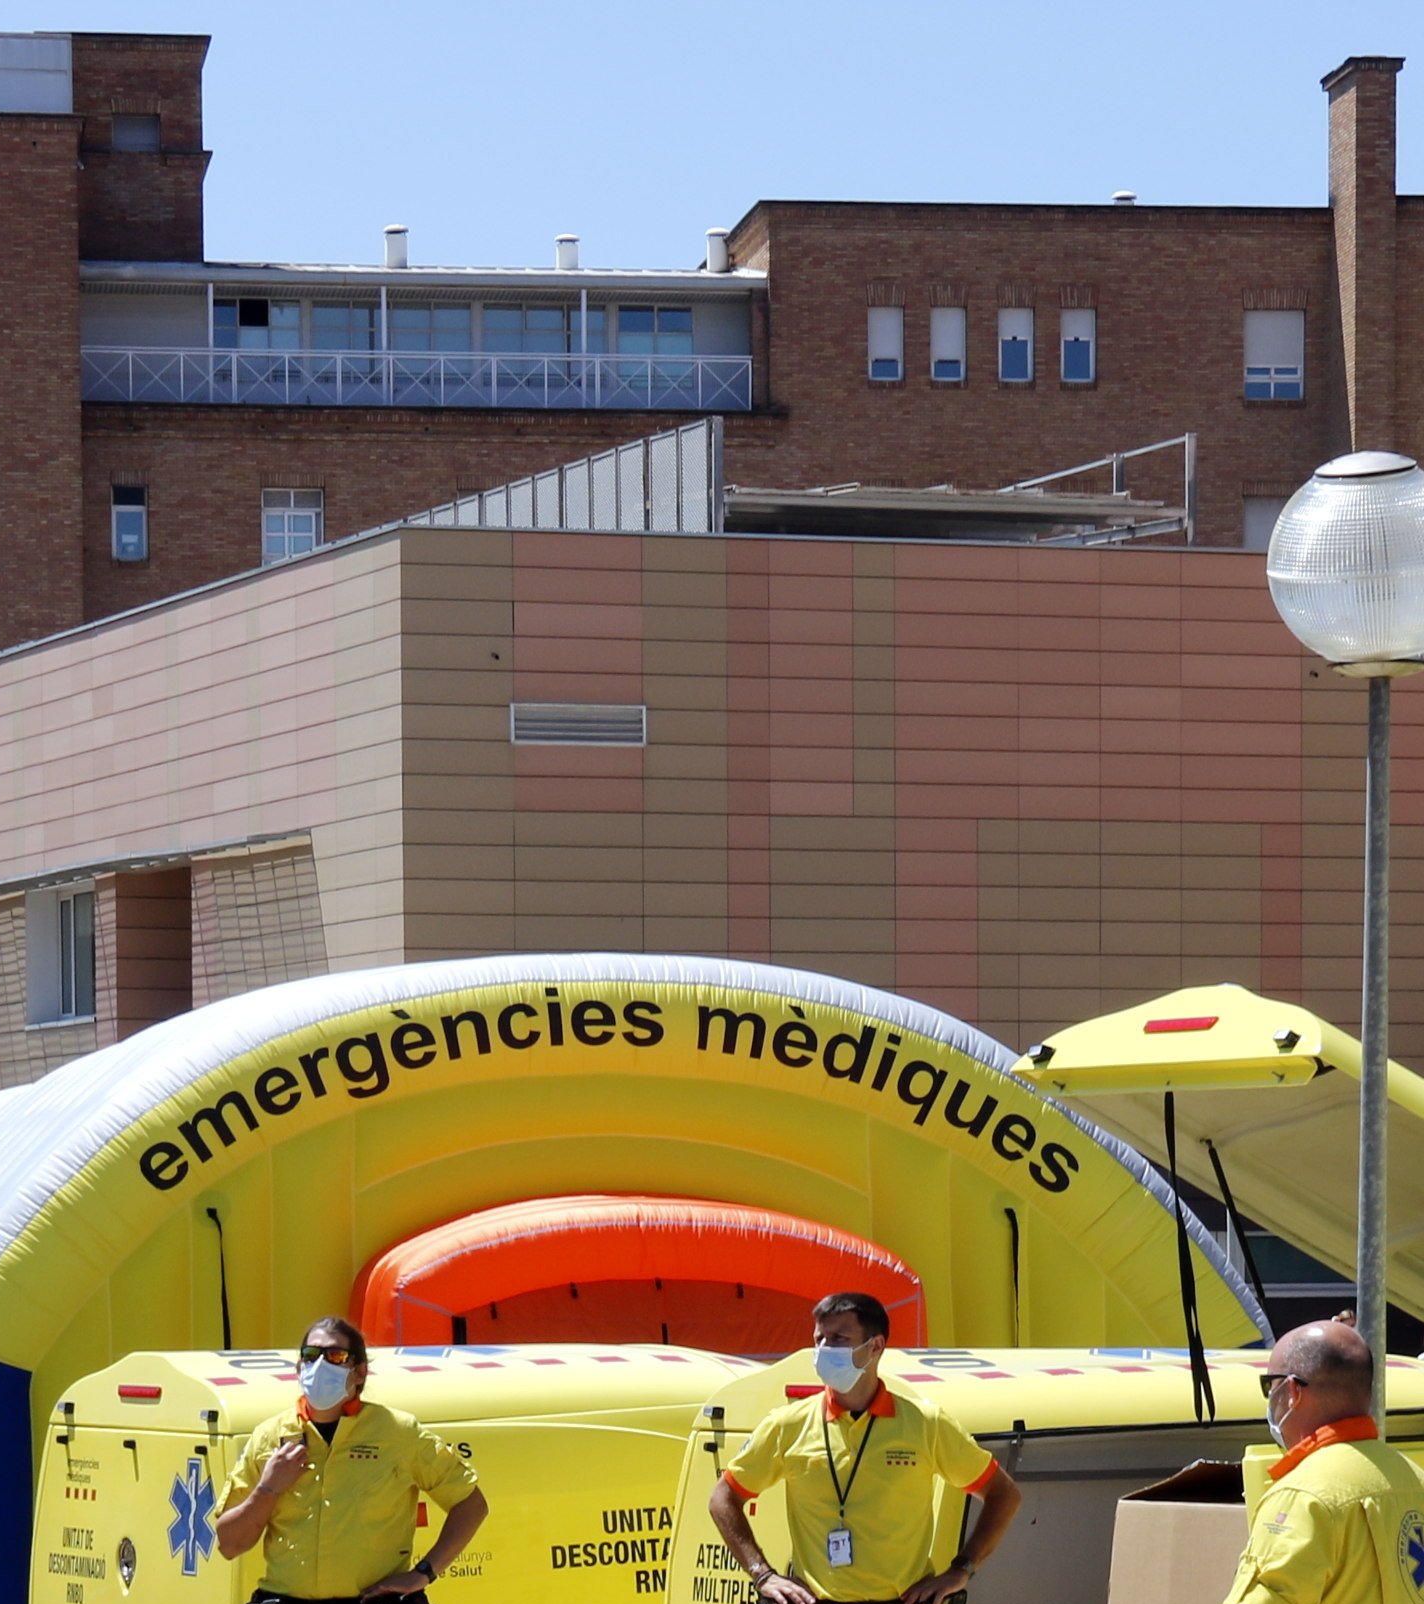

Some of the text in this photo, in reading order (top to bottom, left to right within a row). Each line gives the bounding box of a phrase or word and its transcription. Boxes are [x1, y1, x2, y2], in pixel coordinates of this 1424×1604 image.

[140, 986, 1082, 1194] emergències mèdiques
[602, 1505, 675, 1534] UNITA
[62, 1526, 94, 1550] UNITAT DE
[48, 1553, 106, 1580] DESCONTAMINACIÓ
[550, 1537, 671, 1569] DESCONTA
[450, 1564, 483, 1578] Salut
[635, 1568, 667, 1594] RN
